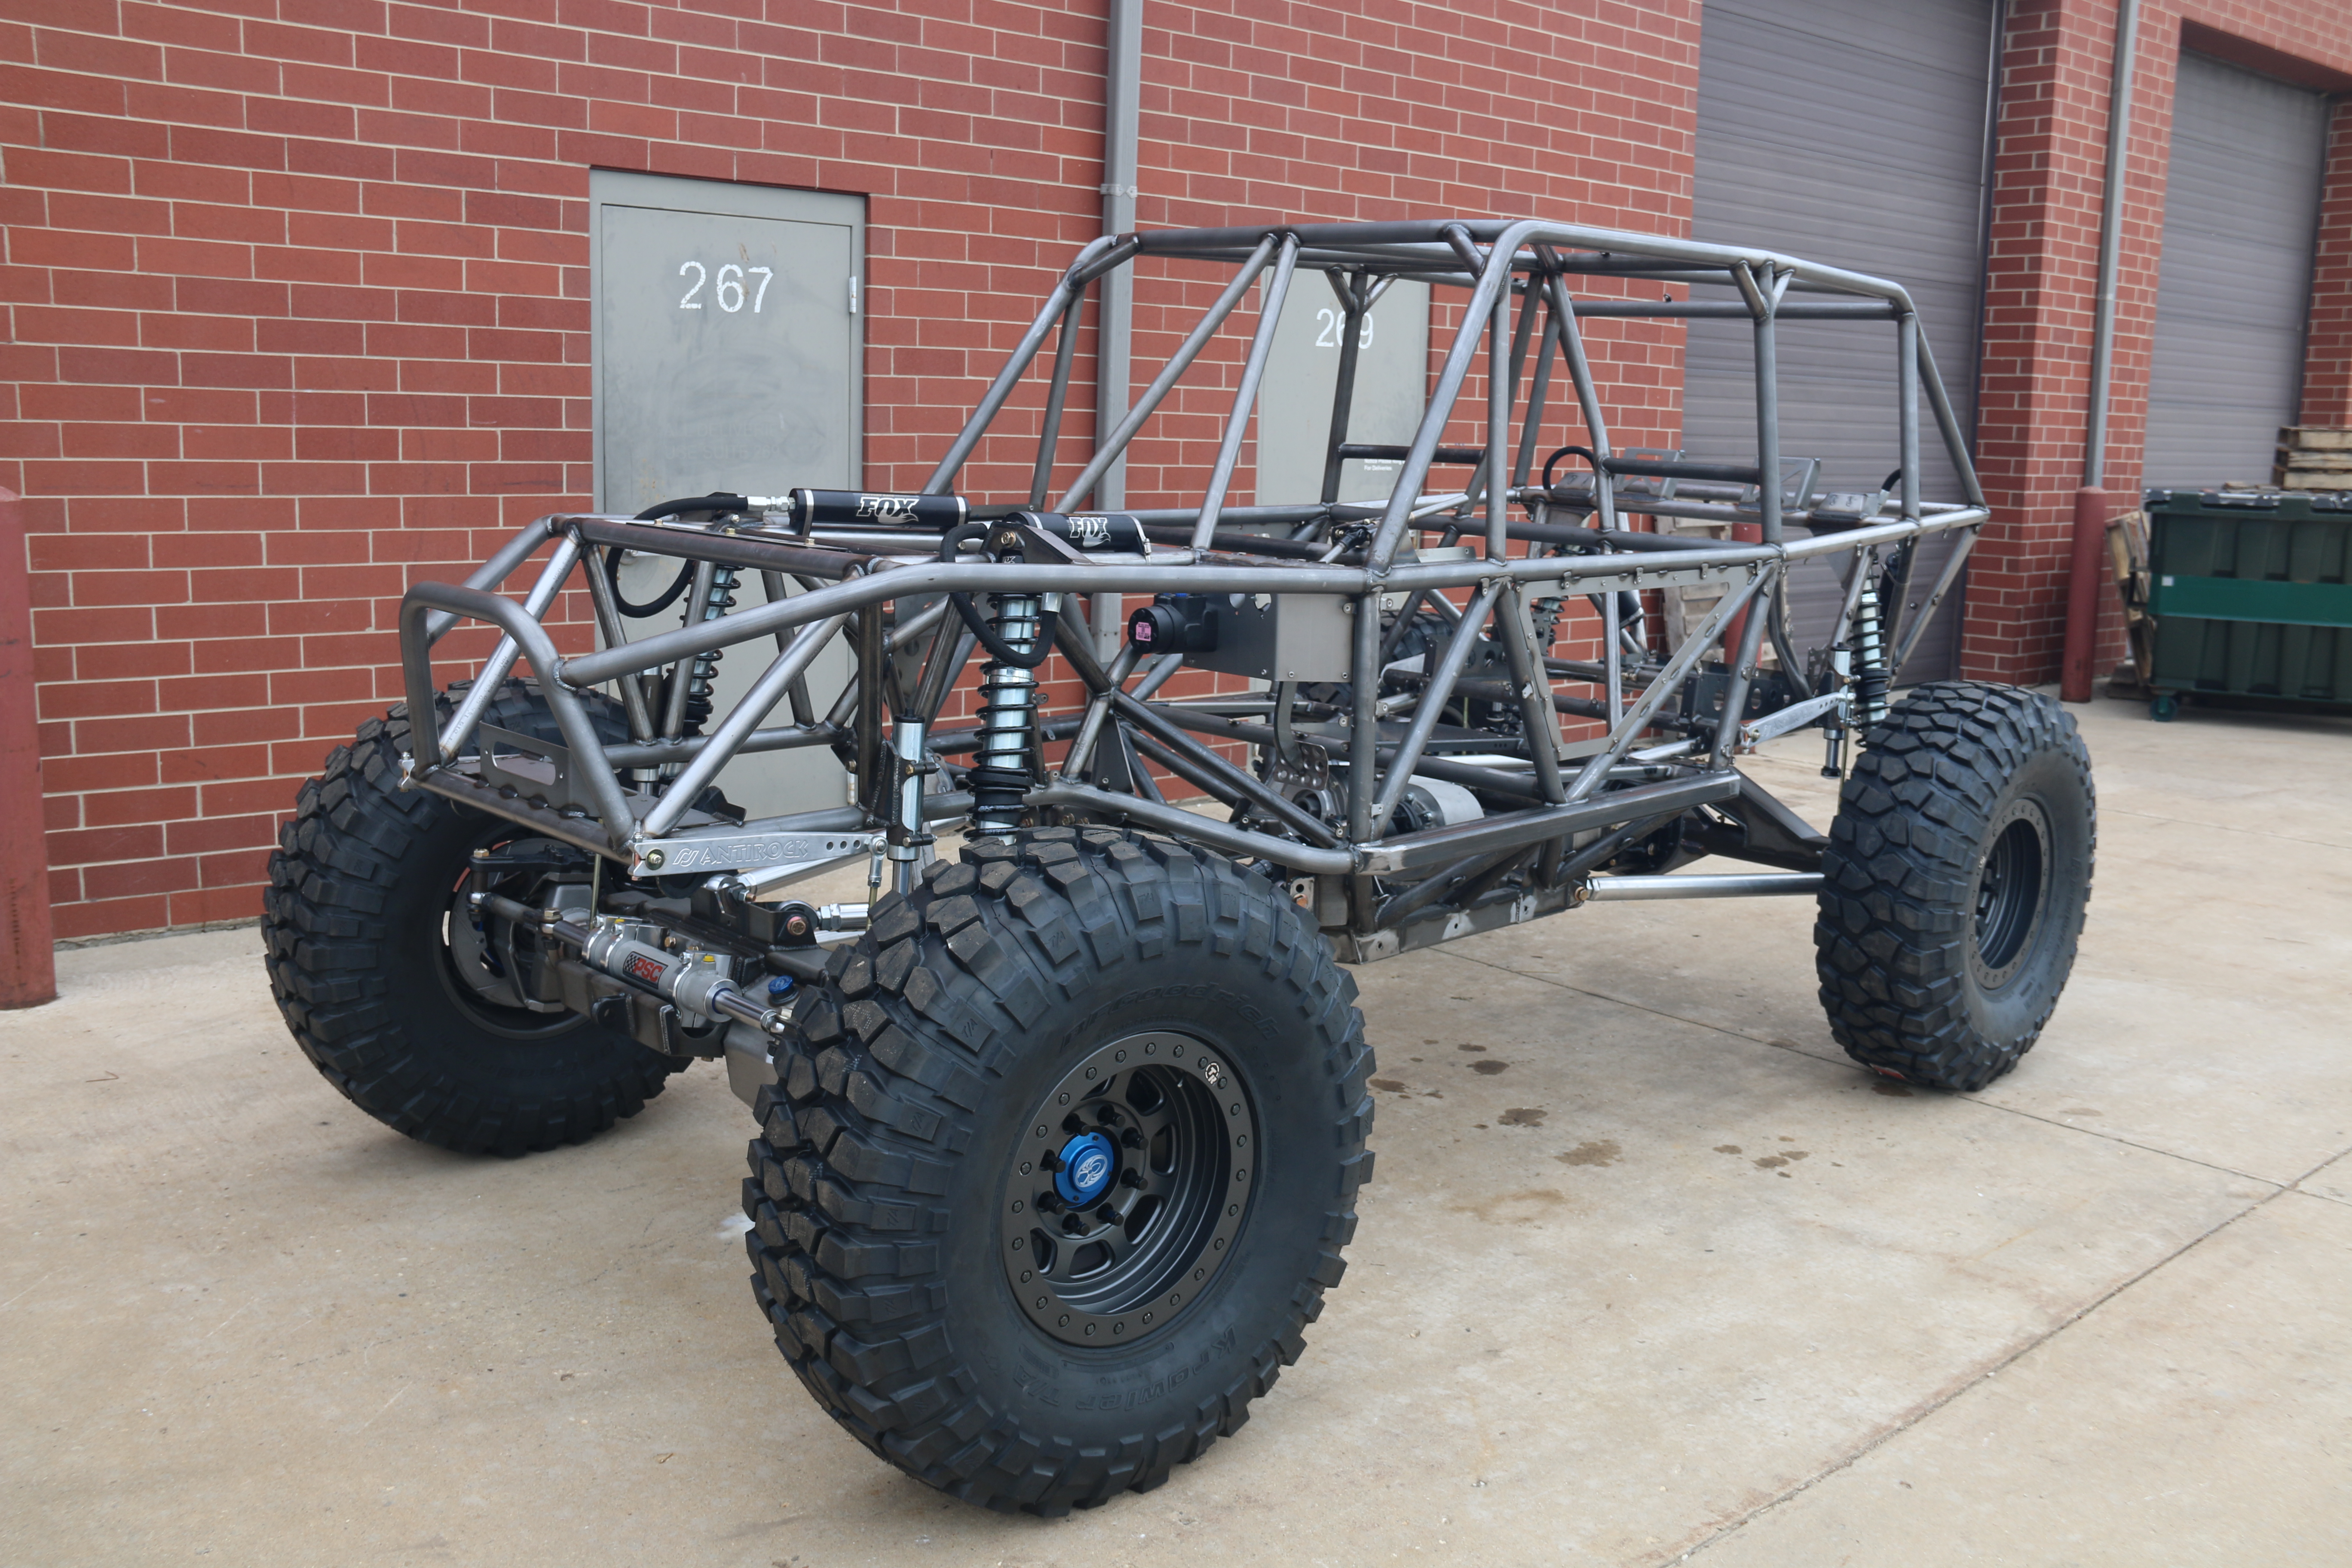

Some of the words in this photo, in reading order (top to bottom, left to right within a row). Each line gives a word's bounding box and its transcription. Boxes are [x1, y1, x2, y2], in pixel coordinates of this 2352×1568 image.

[680, 261, 774, 313] 267
[856, 496, 919, 520] FOX
[1068, 517, 1108, 541] FOX
[699, 840, 808, 866] ANTIROCK
[1048, 930, 1066, 947] T/A
[632, 958, 663, 983] PSC
[962, 1018, 978, 1038] T/A
[1060, 982, 1280, 1053] BFGoodrich
[911, 1112, 925, 1132] T/A
[887, 1208, 899, 1228] T/A
[1076, 1322, 1237, 1411] Krawler
[1012, 1362, 1061, 1406] T/A
